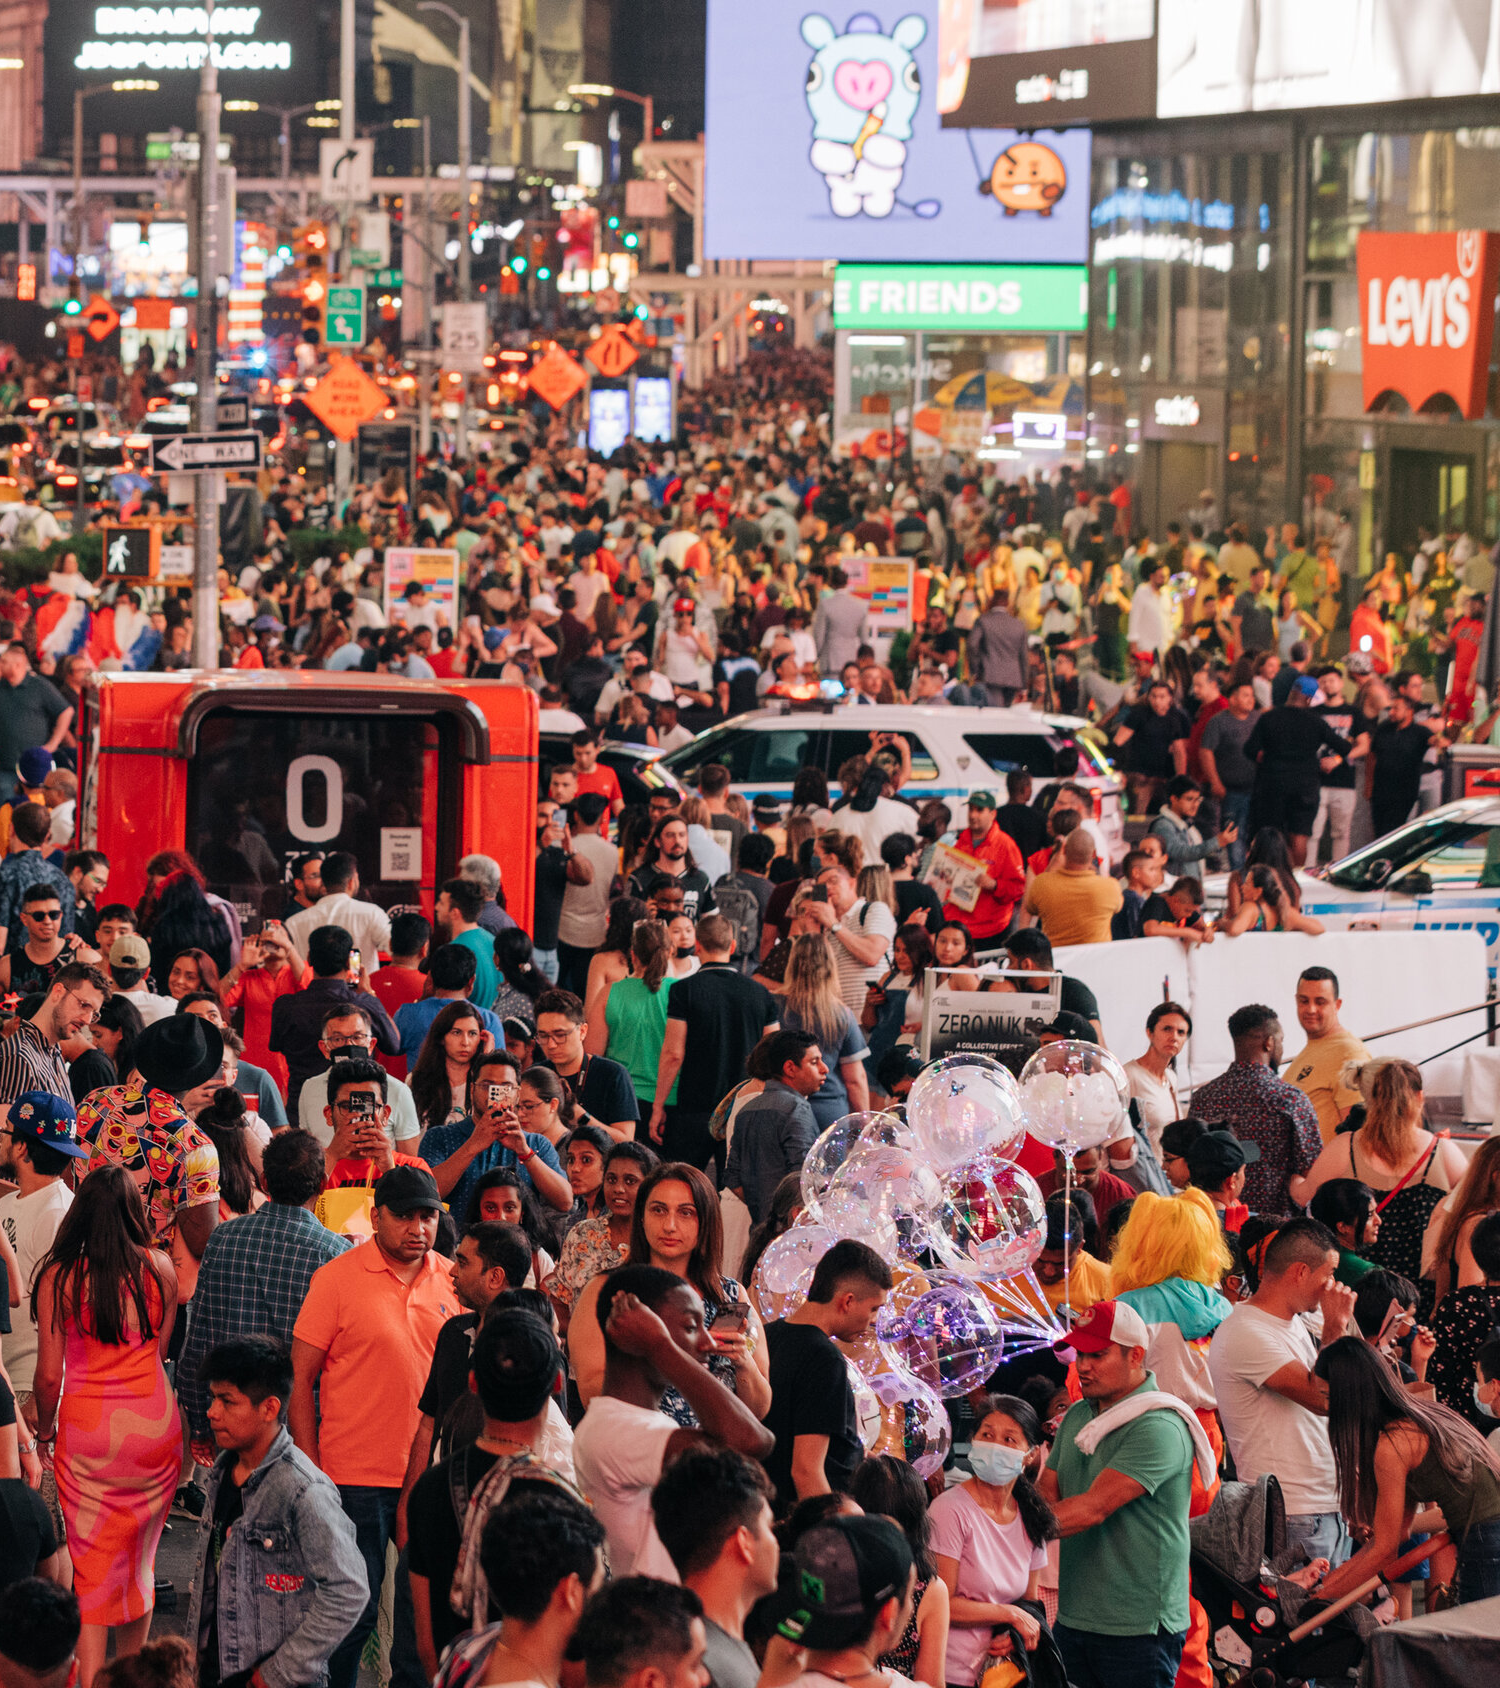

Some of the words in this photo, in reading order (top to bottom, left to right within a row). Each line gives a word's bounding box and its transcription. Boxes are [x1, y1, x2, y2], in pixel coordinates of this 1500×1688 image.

[859, 280, 1022, 314] FRIENDS
[450, 331, 479, 348] 25
[168, 448, 198, 462] ONE
[215, 445, 246, 459] WAY
[939, 1014, 983, 1035] ZERO
[988, 1015, 1044, 1037] NUKE
[961, 1042, 999, 1050] COLLECTIVE
